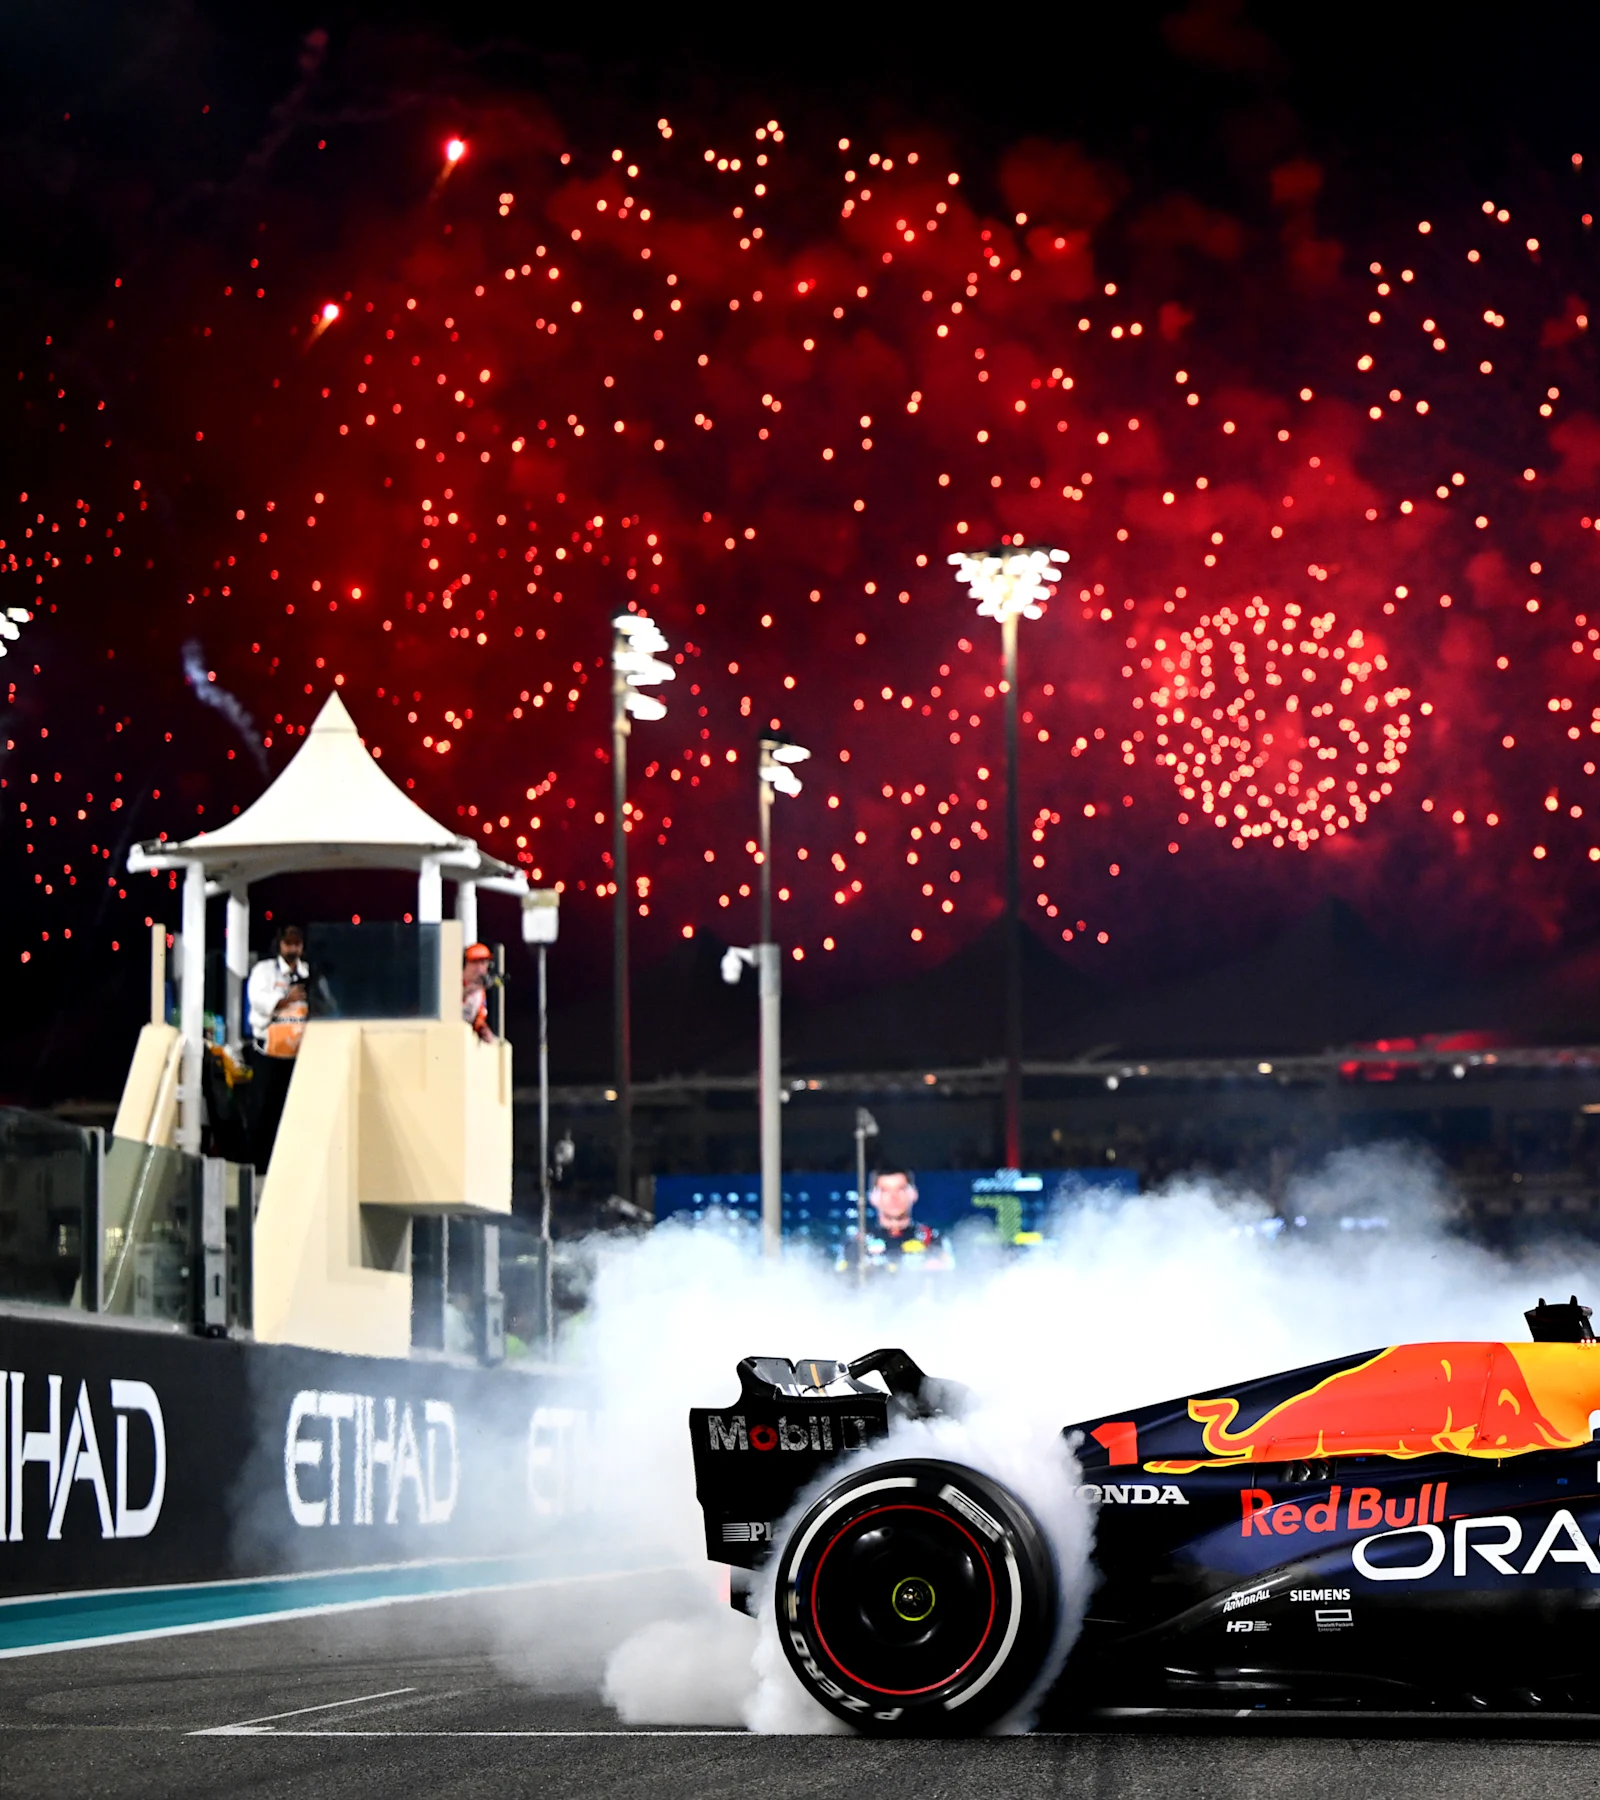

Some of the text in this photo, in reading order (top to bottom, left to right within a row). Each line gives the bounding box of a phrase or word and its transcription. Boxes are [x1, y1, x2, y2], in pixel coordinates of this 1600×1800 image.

[708, 1415, 833, 1451] Mobil
[1090, 1421, 1138, 1466] 1
[284, 1389, 459, 1527] ETIHAD
[1073, 1484, 1189, 1504] ONDA
[1240, 1482, 1448, 1537] Red Bull
[1290, 1588, 1351, 1601] SIEMENS
